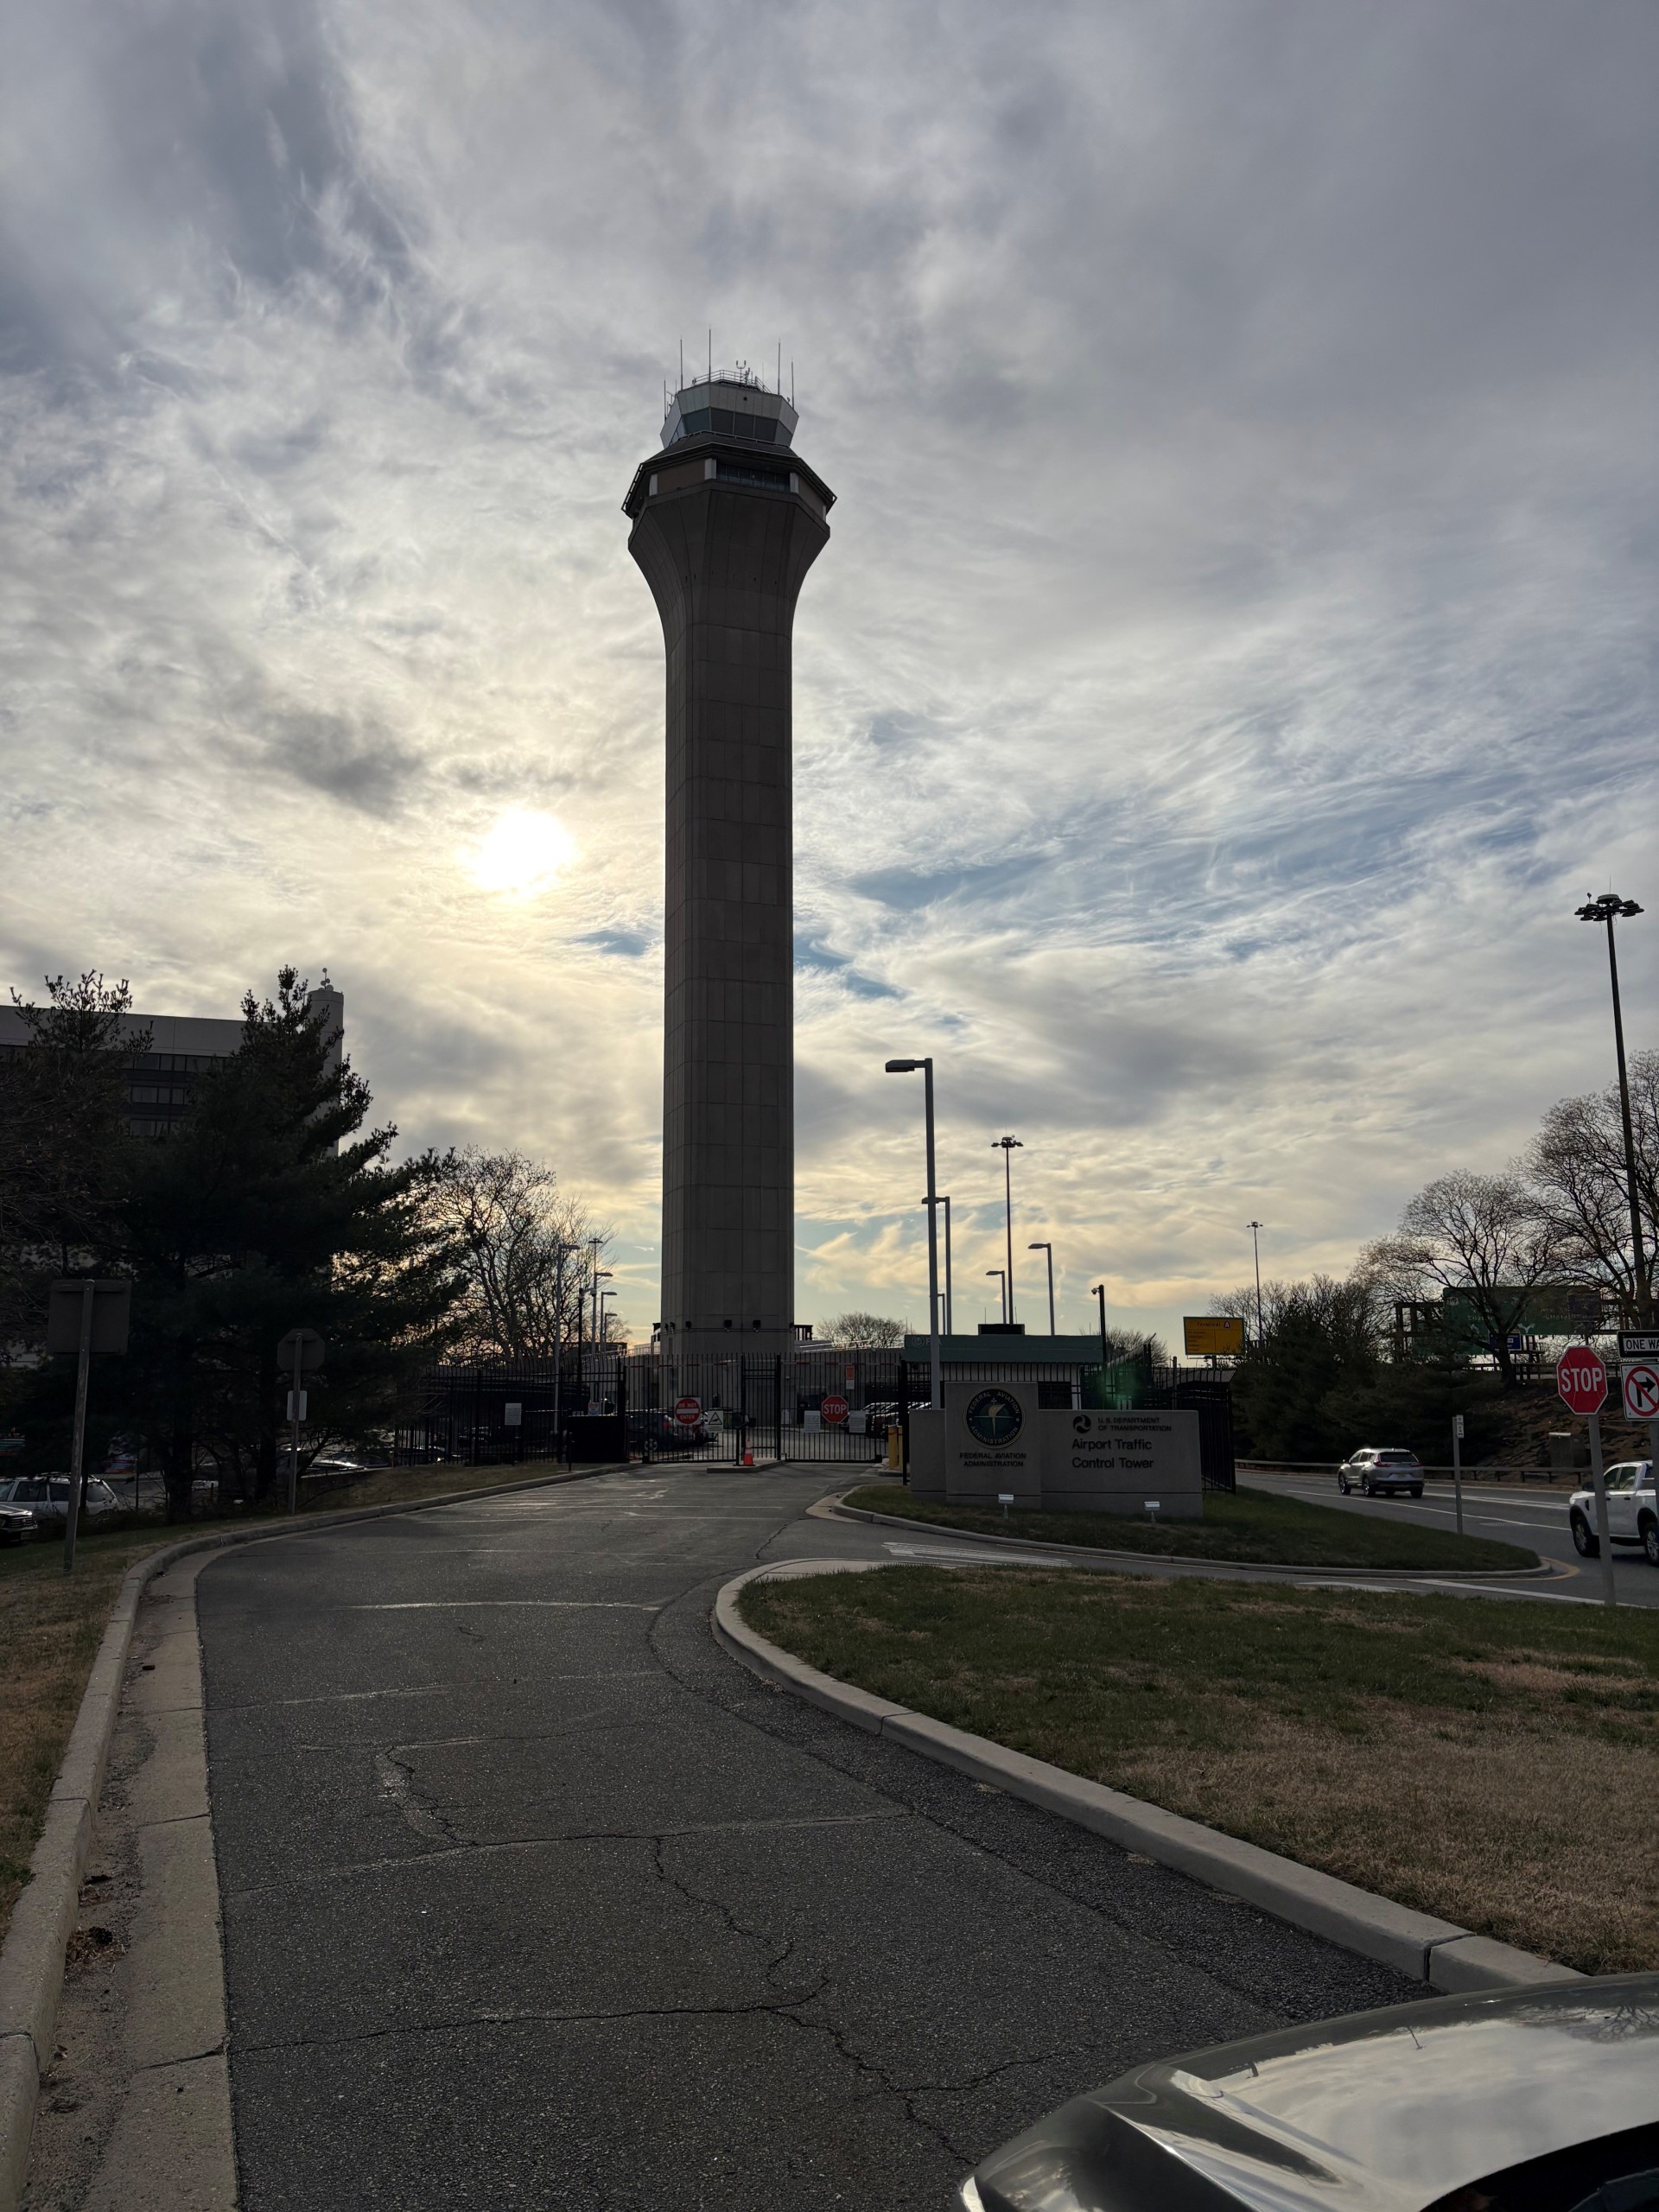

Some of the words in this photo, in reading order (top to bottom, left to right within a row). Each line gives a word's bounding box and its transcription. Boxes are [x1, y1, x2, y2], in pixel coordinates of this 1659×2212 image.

[1626, 1339, 1645, 1350] ONE
[1560, 1367, 1603, 1393] STOP
[823, 1403, 847, 1414] STOP
[968, 1392, 991, 1414] FEDERAL
[997, 1391, 1020, 1414] AVIATION
[970, 1426, 1018, 1445] ADMINISTRATION
[1071, 1438, 1112, 1452] Airport
[1115, 1438, 1152, 1450] Traffic
[1071, 1457, 1115, 1469] Control
[1118, 1457, 1154, 1469] Tower
